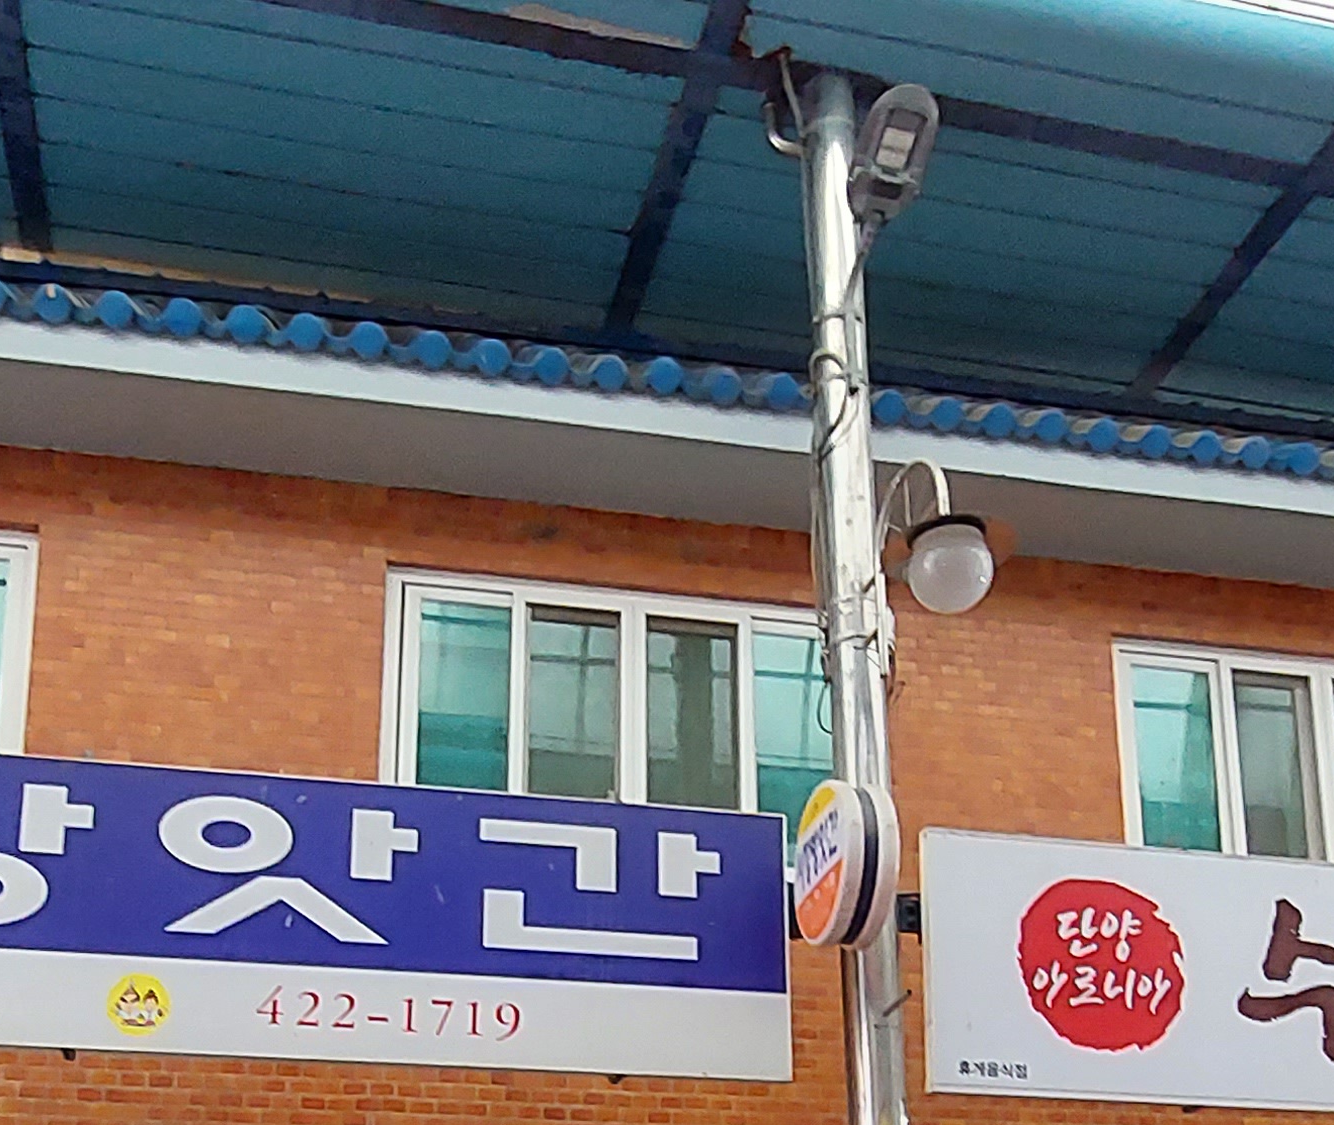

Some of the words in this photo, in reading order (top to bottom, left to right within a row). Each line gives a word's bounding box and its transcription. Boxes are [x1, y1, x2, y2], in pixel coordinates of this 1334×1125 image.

[1056, 906, 1143, 963] 단양
[256, 985, 522, 1042] 422-1719
[1032, 960, 1172, 1016] 아로니아
